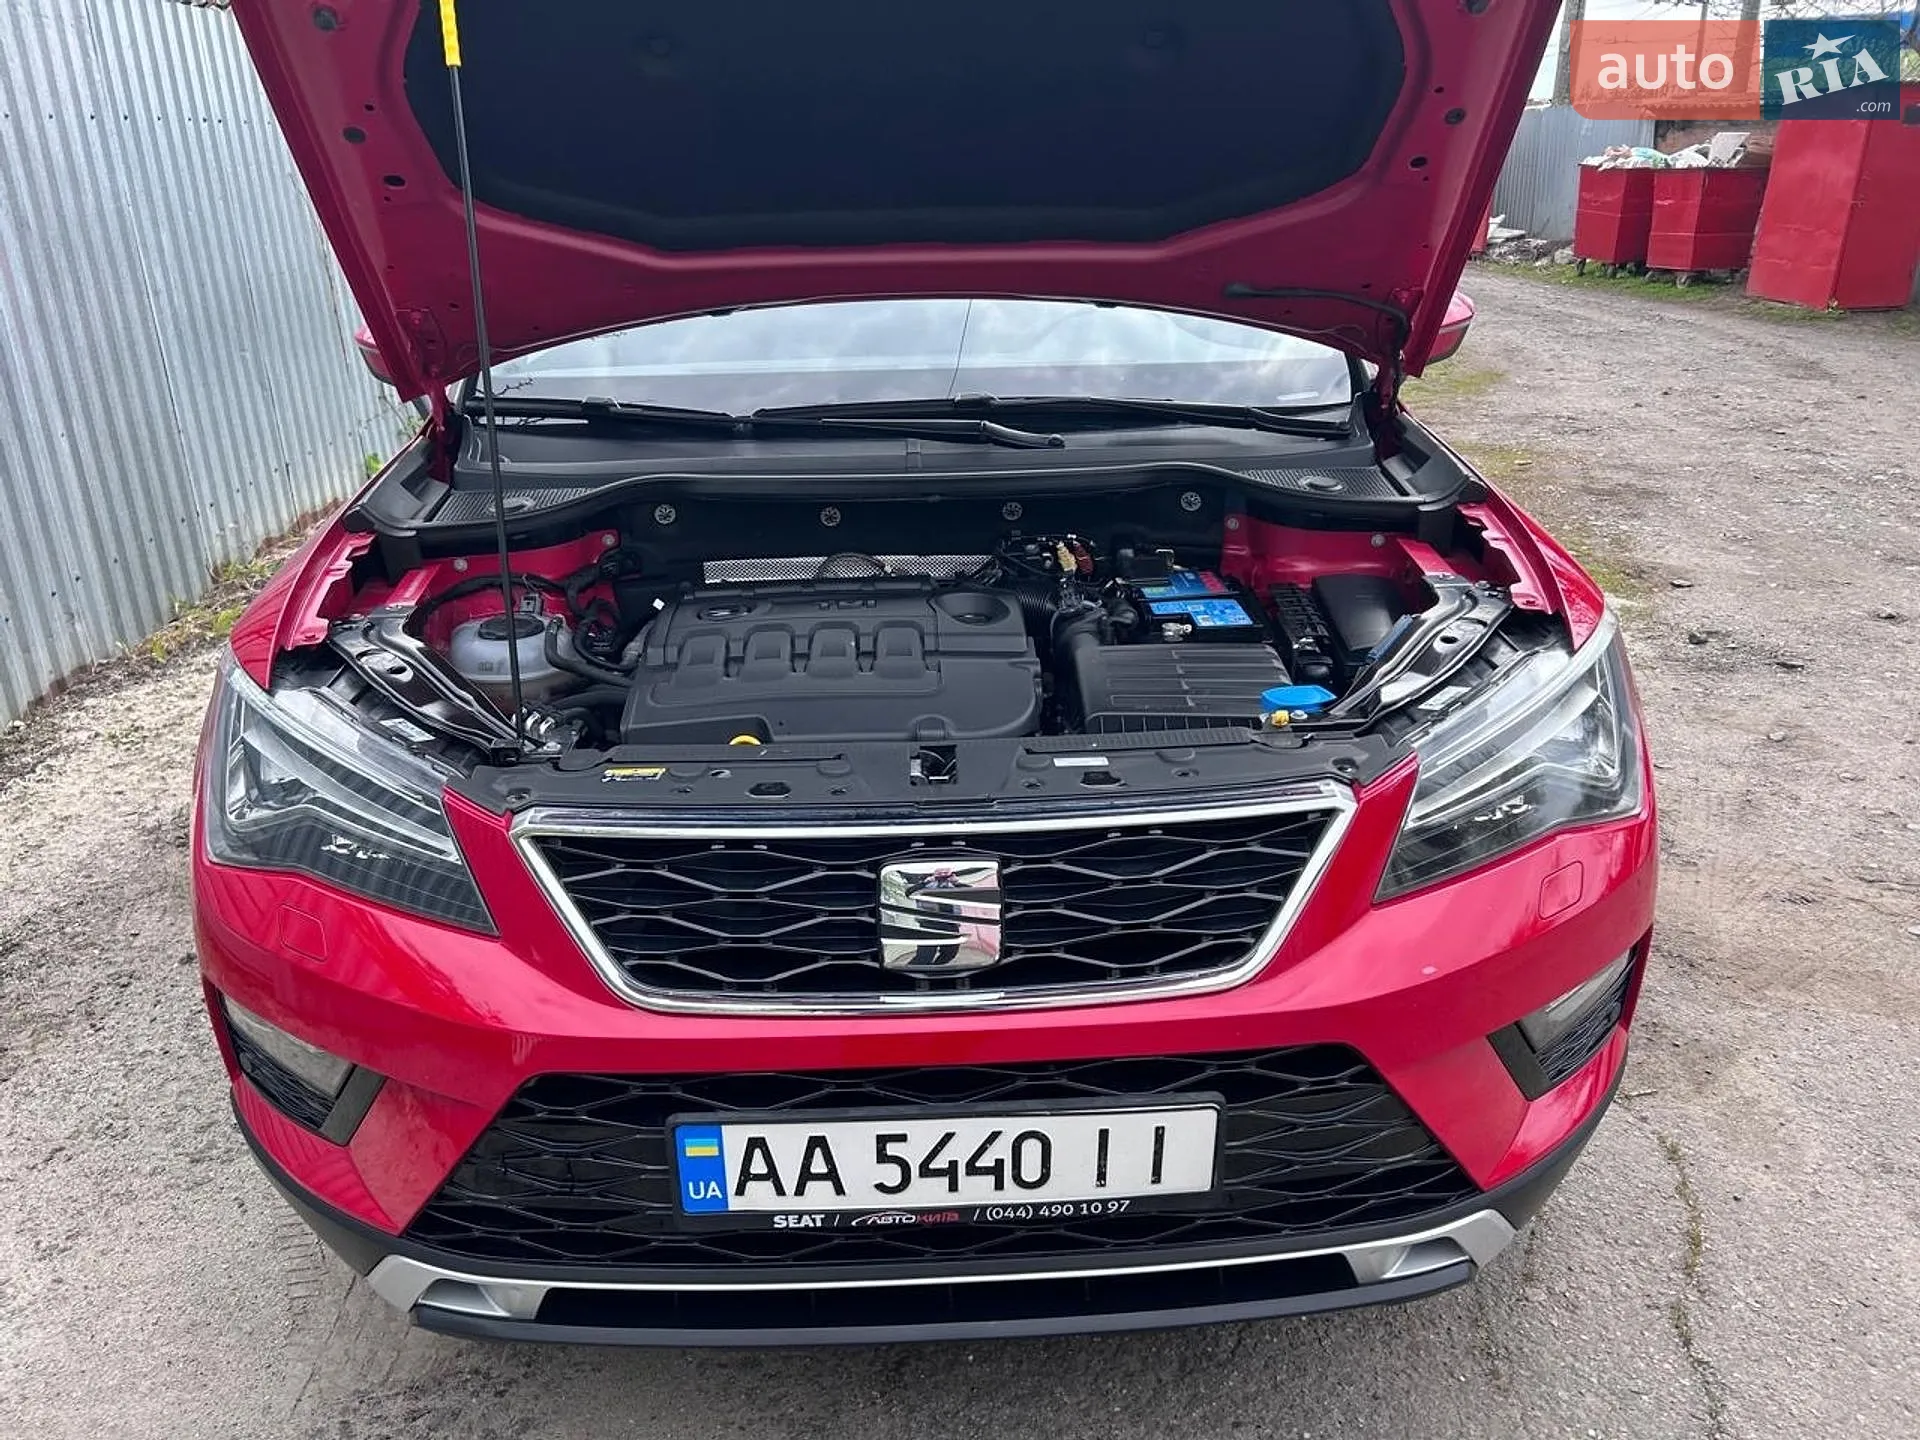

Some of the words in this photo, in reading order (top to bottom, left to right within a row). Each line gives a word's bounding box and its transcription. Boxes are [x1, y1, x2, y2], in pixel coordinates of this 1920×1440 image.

[734, 1135, 847, 1196] AA
[874, 1130, 1052, 1194] 5440
[689, 1180, 722, 1199] UA
[986, 1205, 1034, 1221] (044)
[1039, 1204, 1074, 1217] 490
[1079, 1201, 1102, 1214] 10
[1106, 1200, 1130, 1213] 97
[773, 1214, 825, 1228] SEAT
